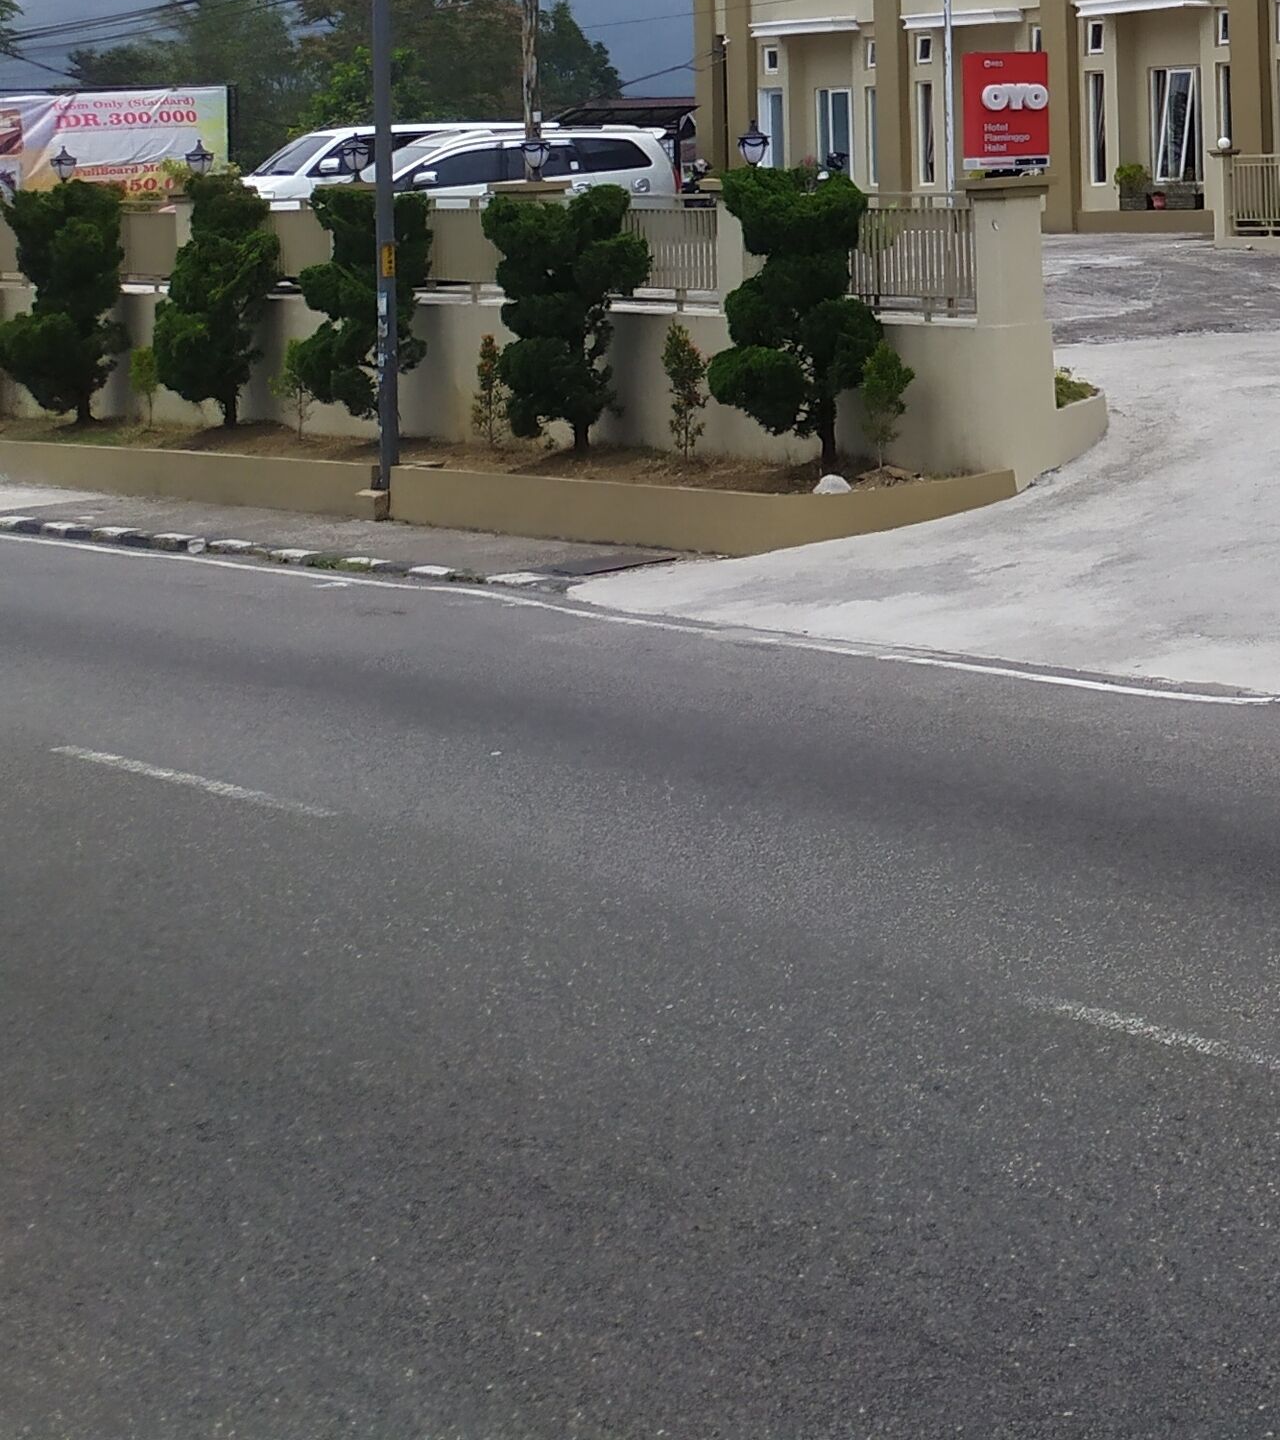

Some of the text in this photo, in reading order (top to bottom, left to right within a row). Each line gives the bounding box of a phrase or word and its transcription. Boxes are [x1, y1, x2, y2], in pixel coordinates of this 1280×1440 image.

[982, 82, 1050, 111] OYO
[93, 99, 124, 110] Only
[54, 110, 198, 129] IDR.300.000
[983, 123, 1009, 132] Hotel
[983, 133, 1031, 143] Flaminggo
[983, 143, 1007, 152] Halal
